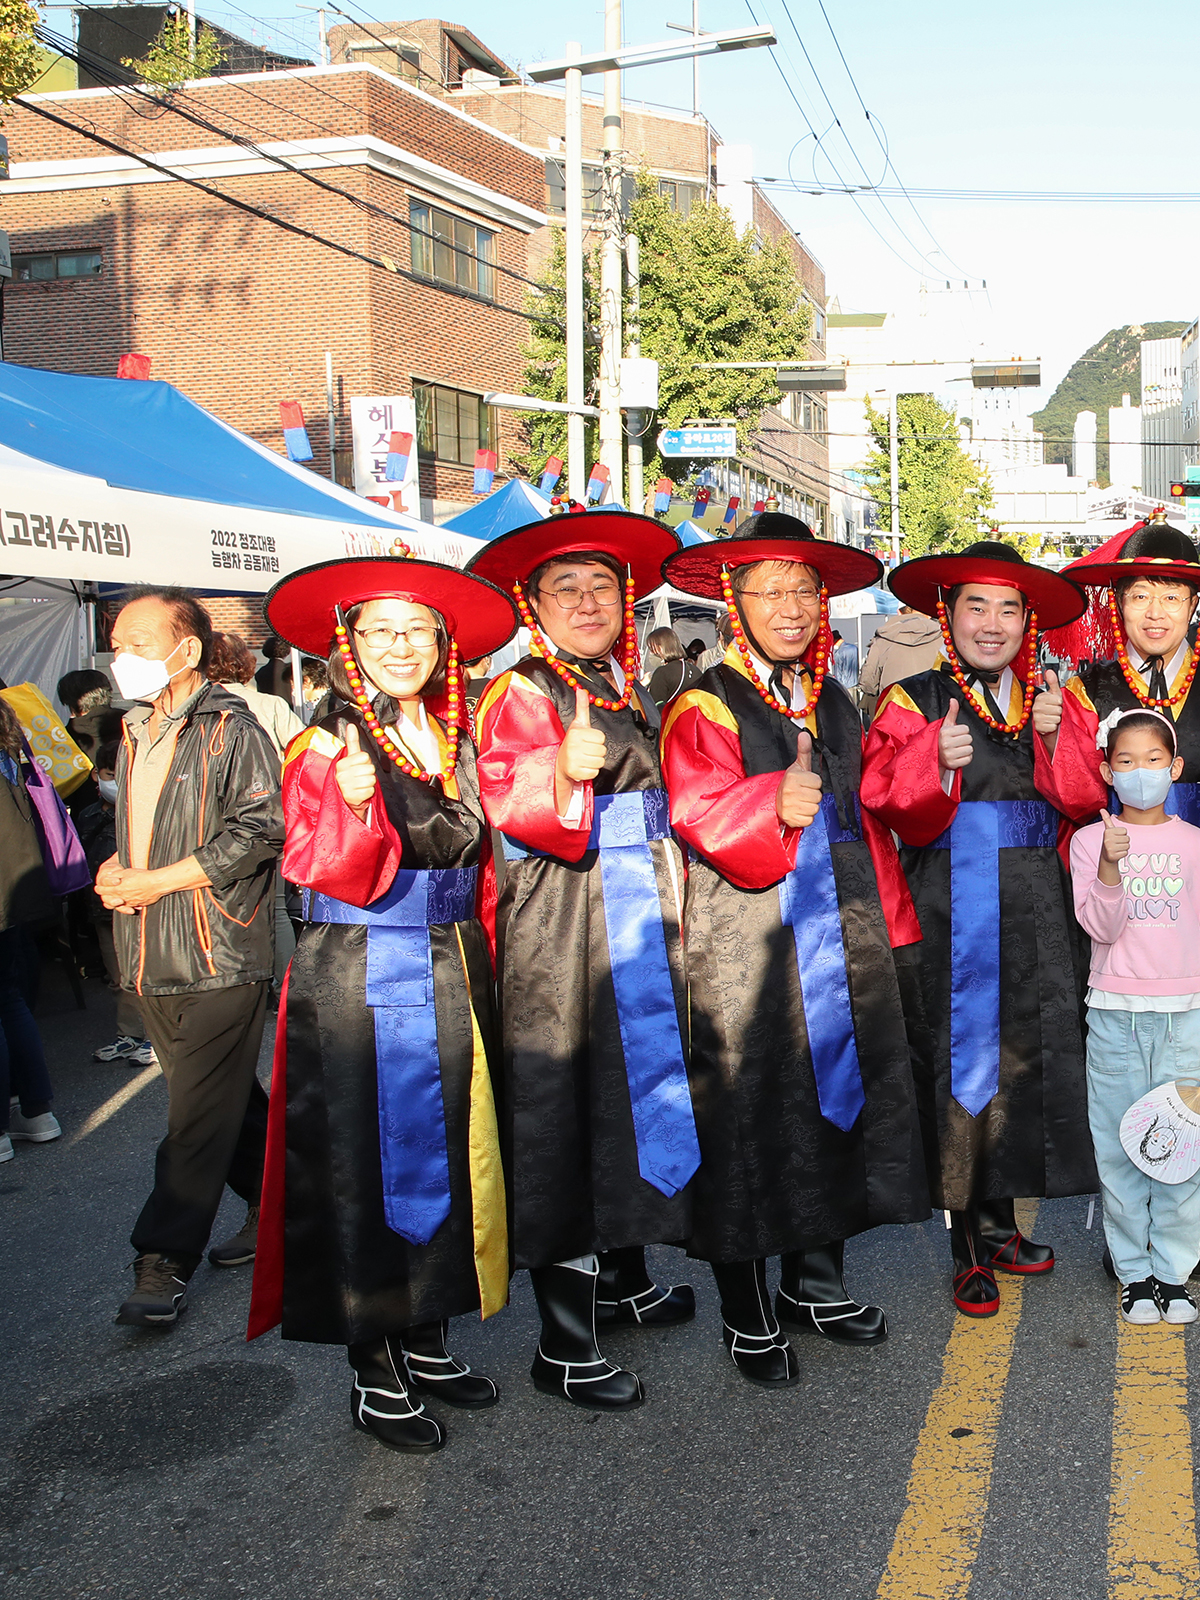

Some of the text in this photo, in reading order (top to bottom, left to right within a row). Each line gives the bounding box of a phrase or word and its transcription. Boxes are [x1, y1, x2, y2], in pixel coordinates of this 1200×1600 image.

[211, 529, 276, 553] 2022 정조대왕
[211, 550, 280, 573] 능행차 공동재현
